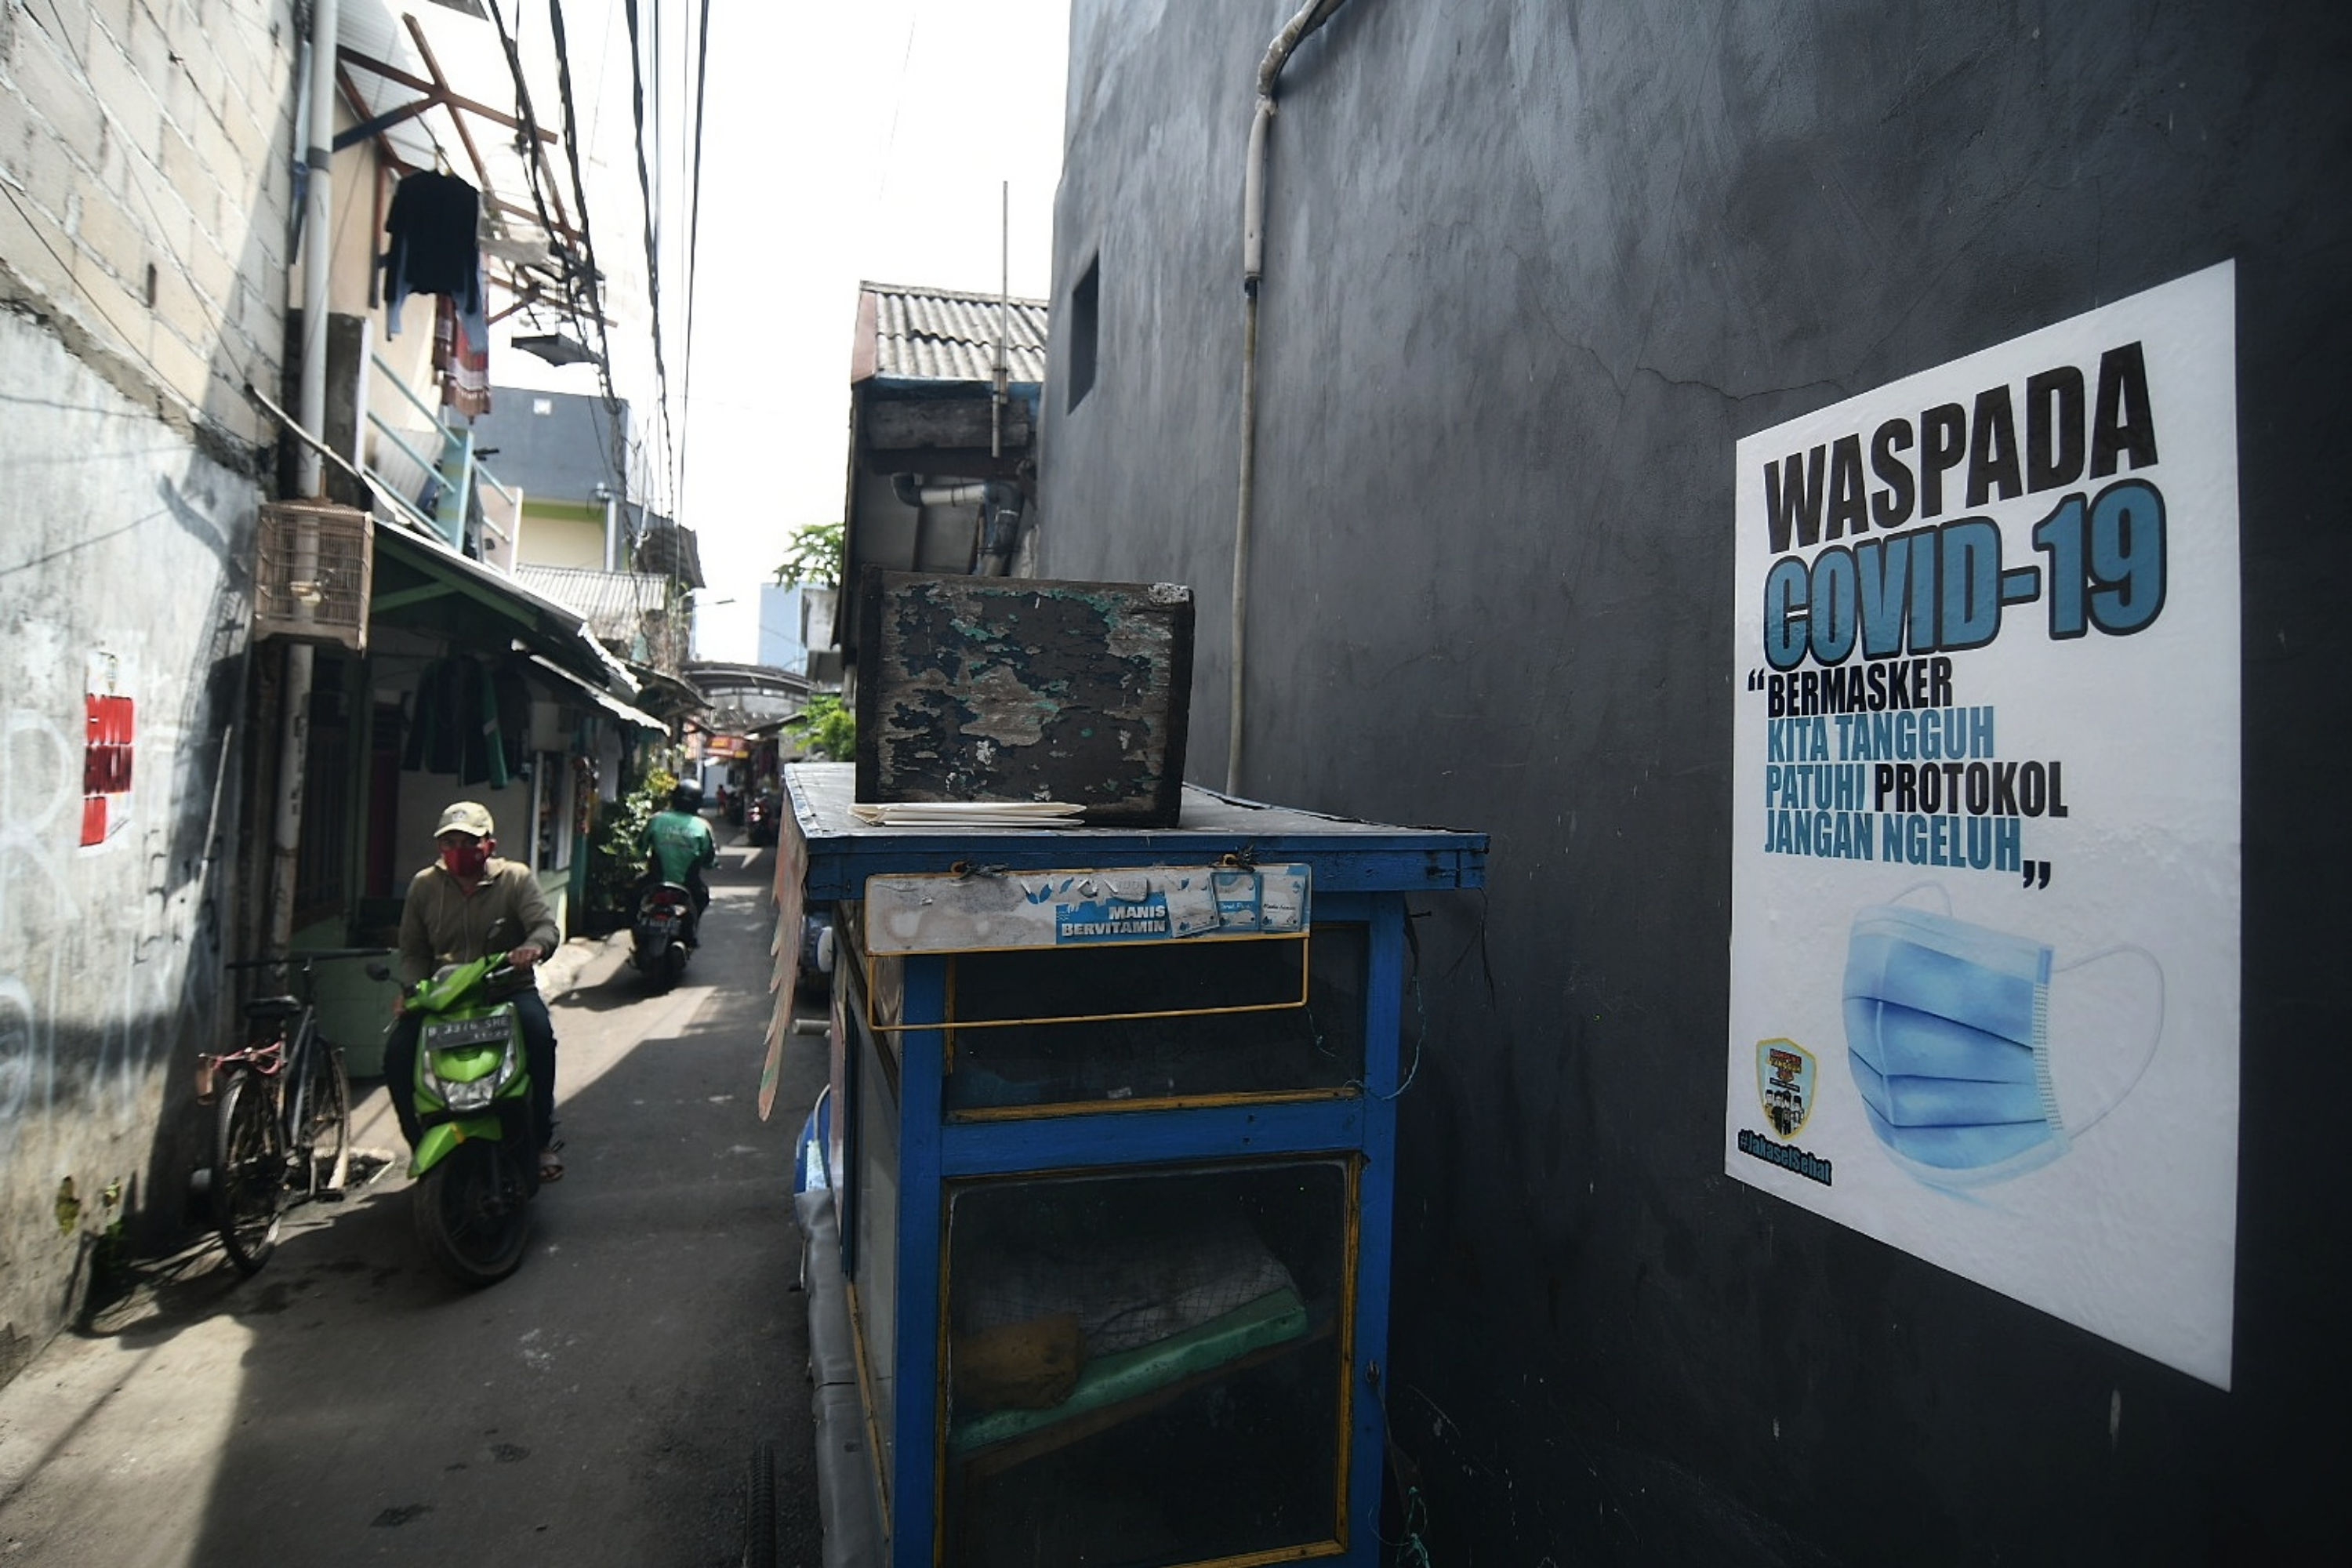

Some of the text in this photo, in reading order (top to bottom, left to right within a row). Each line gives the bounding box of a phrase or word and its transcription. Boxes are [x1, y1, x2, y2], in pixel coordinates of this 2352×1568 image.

[1764, 340, 2159, 554] WASPADA
[1763, 477, 2167, 672] COVID-19
[1767, 706, 1994, 763] KITA TANGGUH
[1766, 760, 2068, 818] PATUHI PROTOKOL
[1765, 811, 1873, 861] JANGAN
[1062, 920, 1166, 937] BERVITAMIN
[1109, 906, 1165, 920] MANIS
